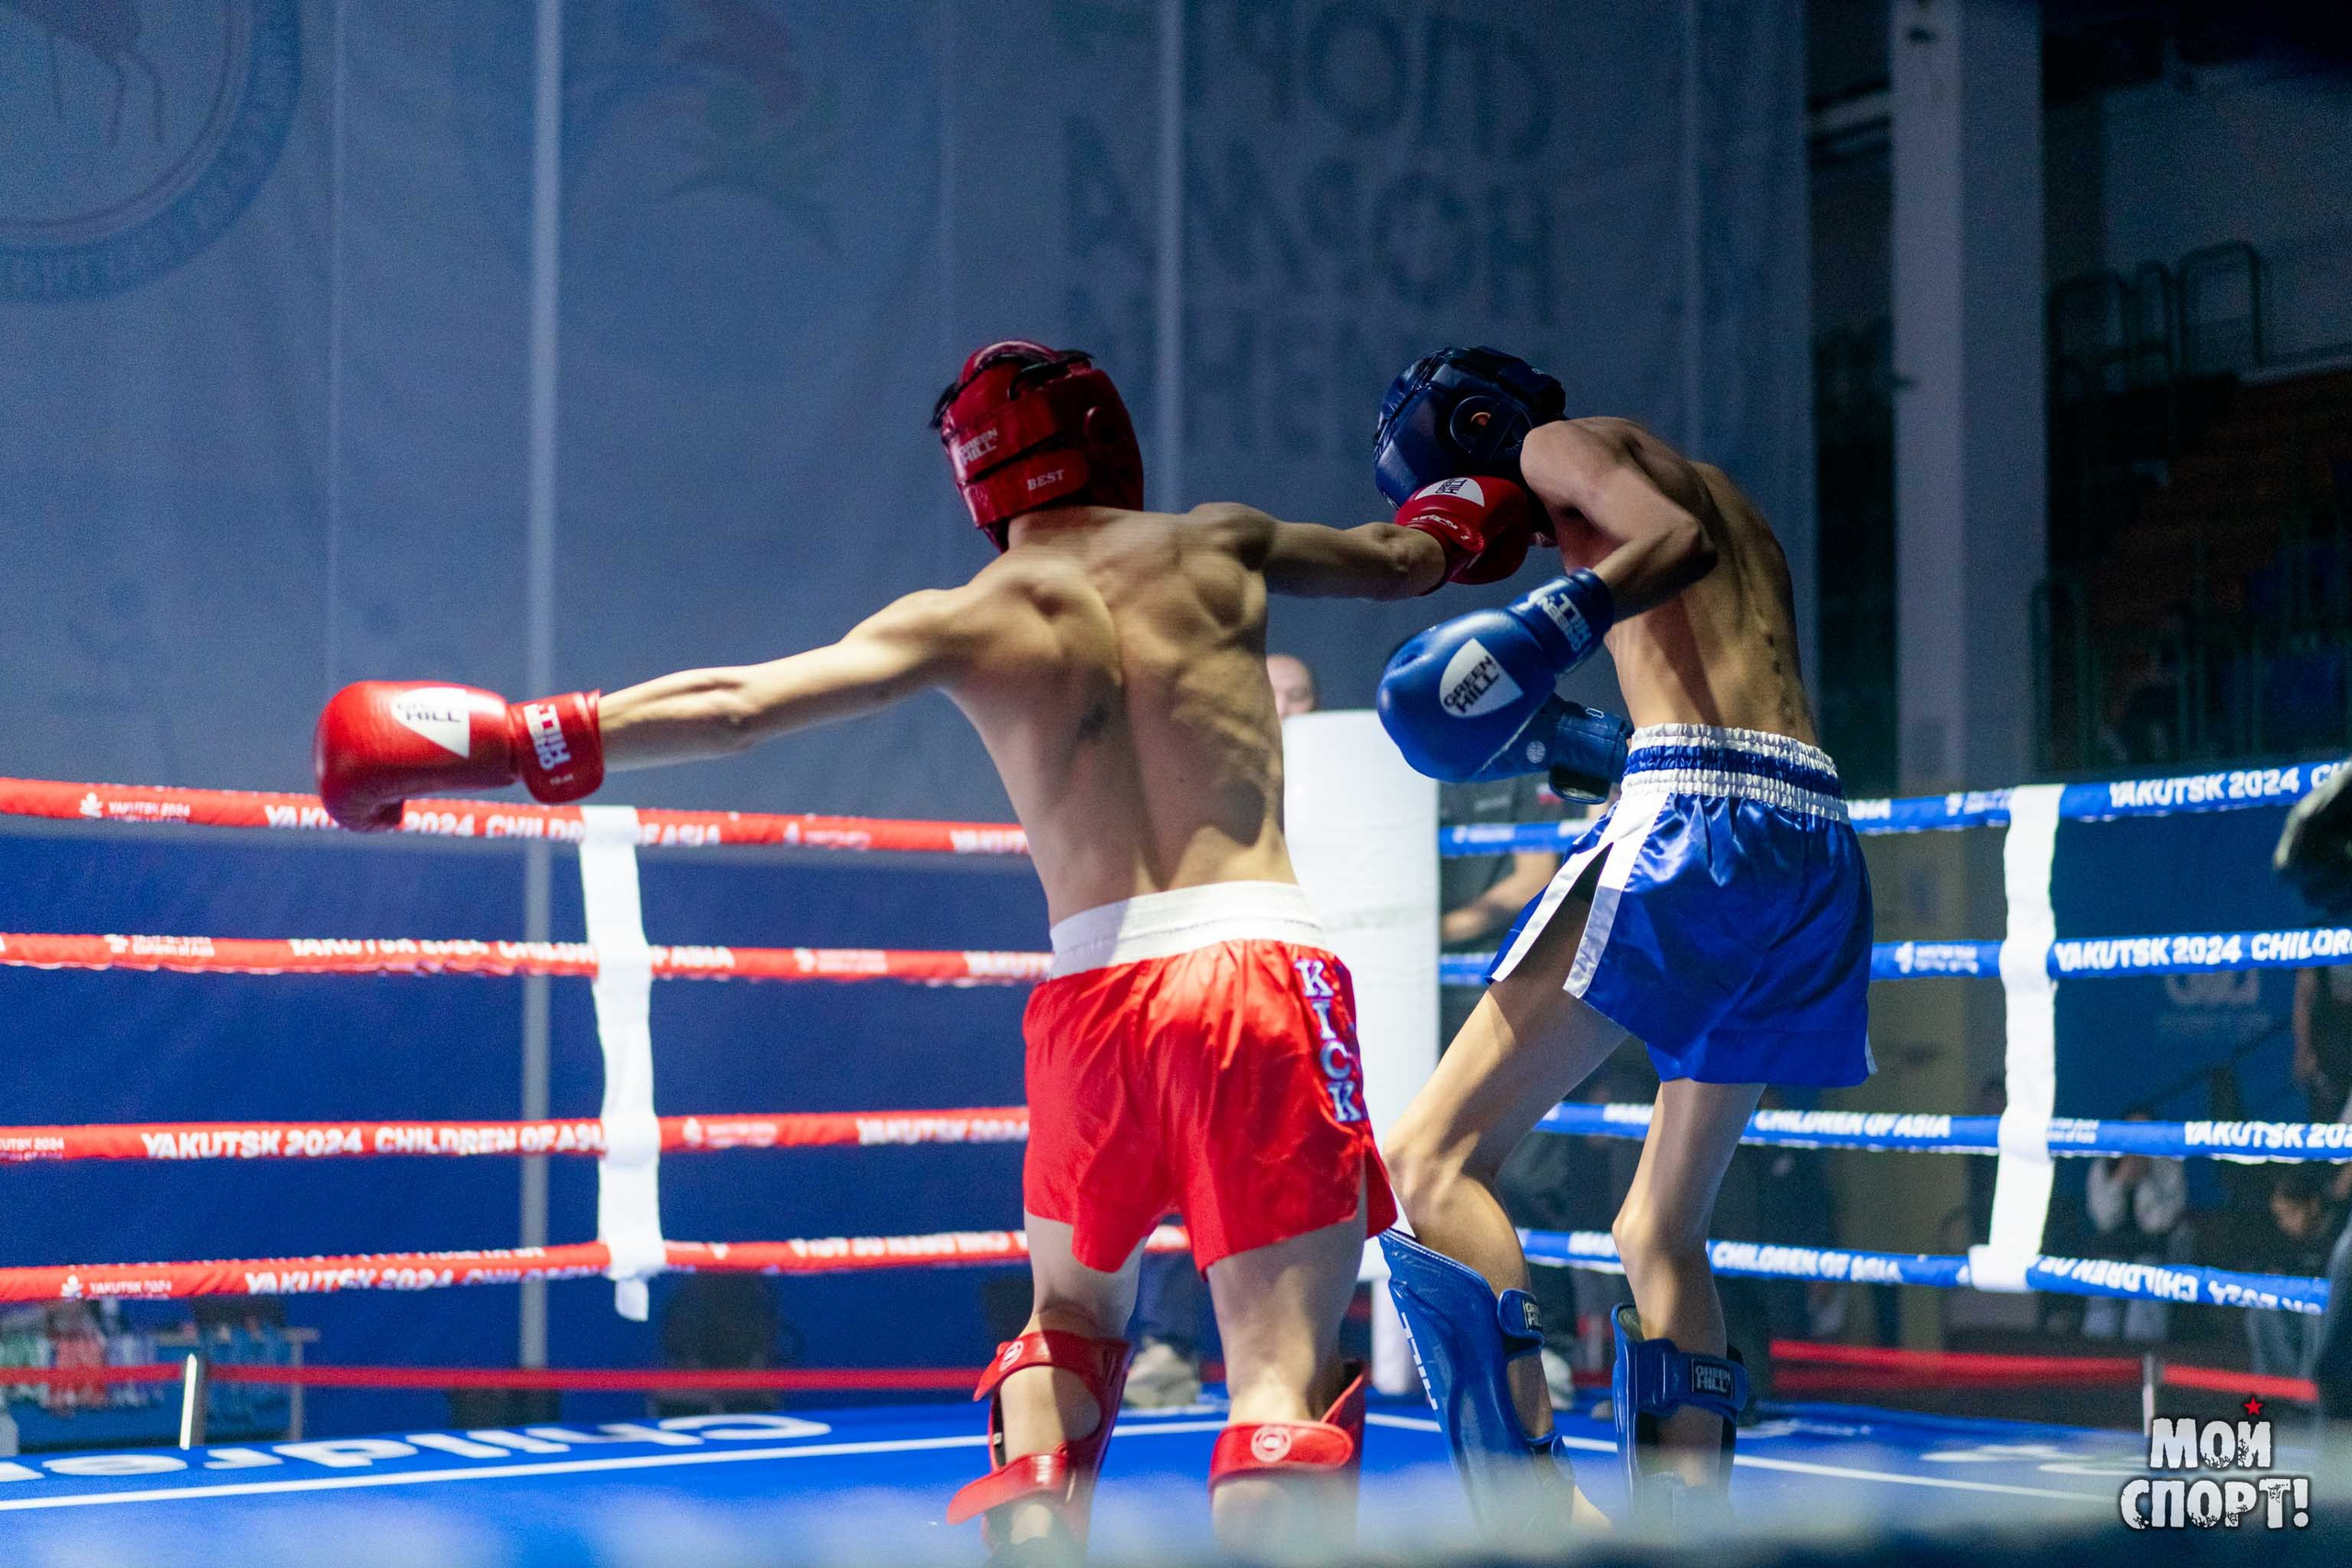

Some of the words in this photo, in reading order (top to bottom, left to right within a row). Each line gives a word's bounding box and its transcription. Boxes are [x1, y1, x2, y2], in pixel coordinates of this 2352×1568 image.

[1027, 469, 1065, 491] BEST
[1445, 479, 1468, 494] HILL
[1443, 655, 1497, 708] GREEN
[1455, 673, 1500, 714] HILL
[405, 710, 461, 724] HILL
[2109, 773, 2227, 808] YAKUTSK
[2227, 767, 2301, 799] 2024
[2054, 937, 2170, 972] YAKUTSK
[2172, 934, 2243, 964] 2024
[2251, 928, 2352, 961] CHILDR
[1295, 958, 1363, 1122] KICK
[141, 1130, 281, 1158] YAKUTSK
[286, 1128, 362, 1156] 2024
[375, 1126, 517, 1156] CHILDREN
[2184, 1120, 2307, 1149] YAKUTSK
[1713, 1242, 1819, 1276] CHILDREN
[244, 1269, 378, 1295] YAKUTSK
[1696, 1375, 1727, 1393] HILL
